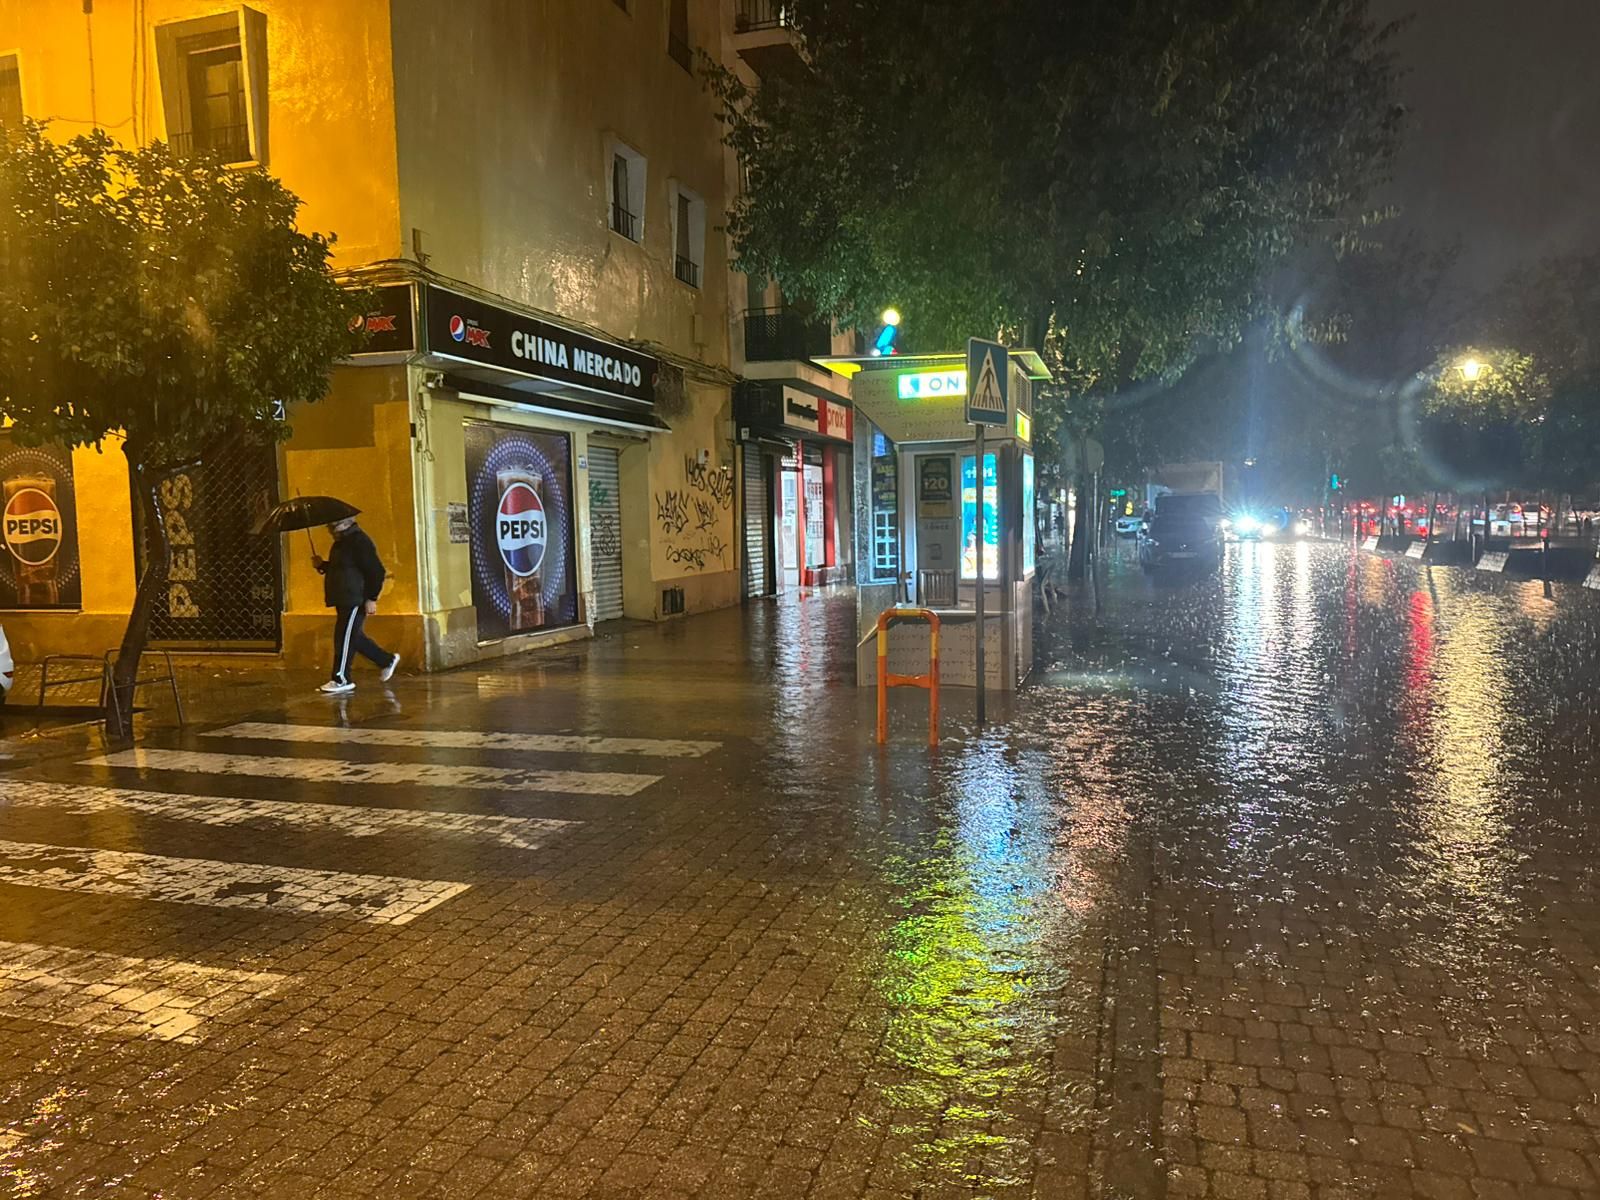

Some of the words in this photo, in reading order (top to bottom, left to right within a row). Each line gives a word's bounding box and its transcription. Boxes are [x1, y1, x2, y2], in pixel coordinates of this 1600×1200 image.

[511, 330, 569, 370] CHINA
[573, 347, 641, 387] MERCADO
[929, 376, 959, 391] ON
[7, 516, 58, 535] PEPSI
[500, 519, 544, 541] PEPSI
[161, 473, 199, 618] PEPS
